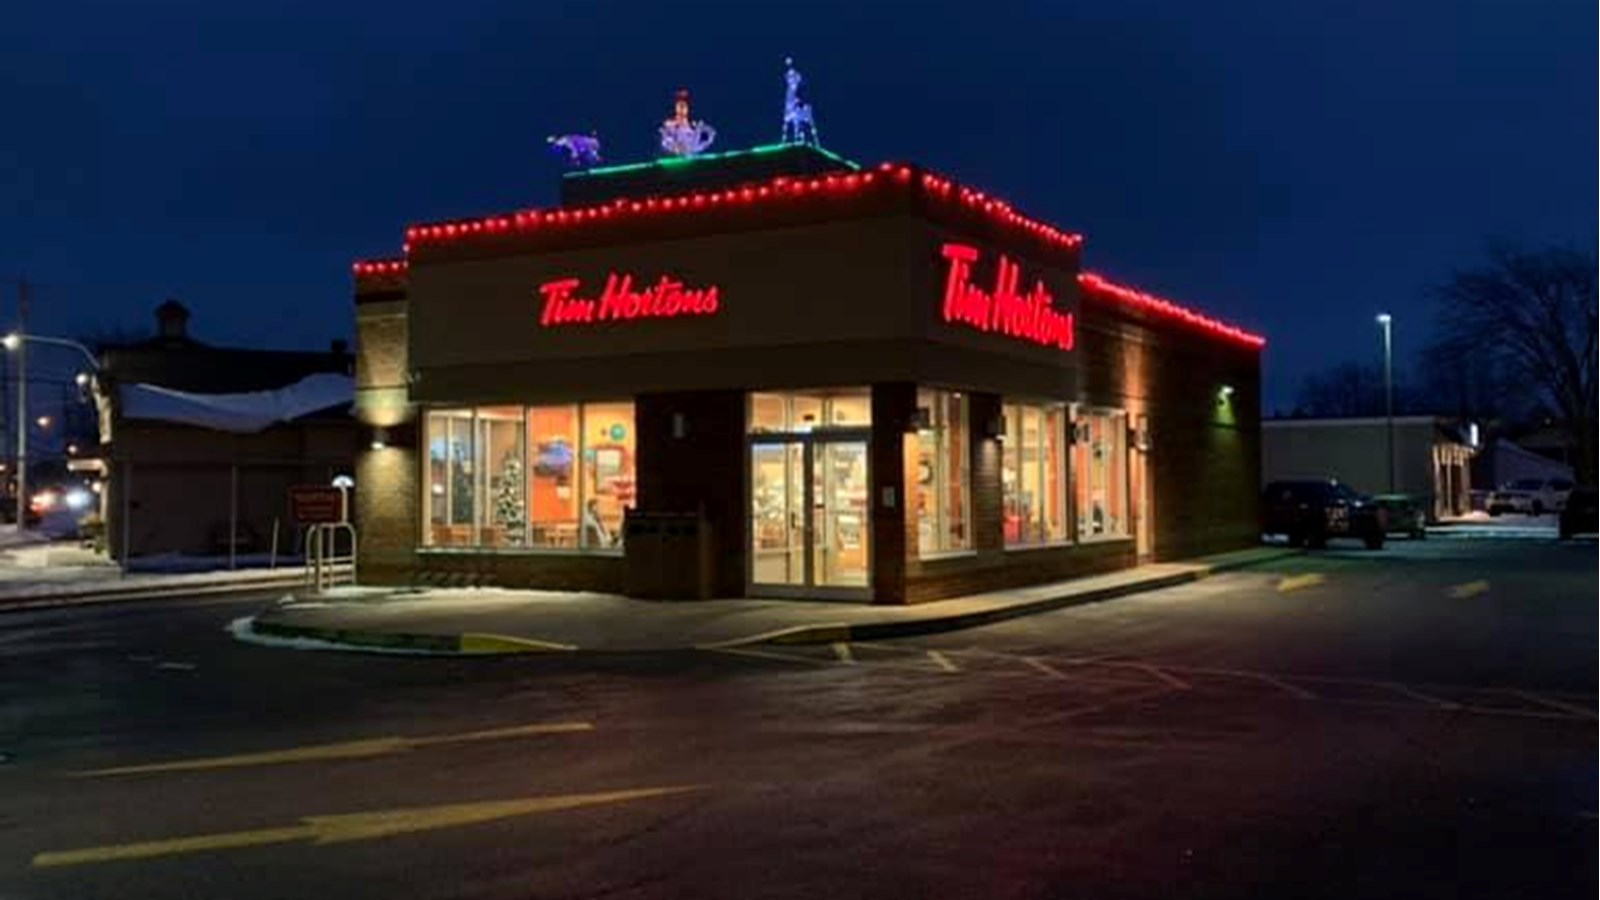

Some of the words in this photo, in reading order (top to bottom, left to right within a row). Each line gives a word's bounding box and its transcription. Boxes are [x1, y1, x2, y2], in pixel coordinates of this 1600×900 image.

[539, 278, 596, 326] Tim
[597, 273, 719, 321] Hortons
[942, 243, 991, 332] Tim
[992, 253, 1075, 351] Hortons
